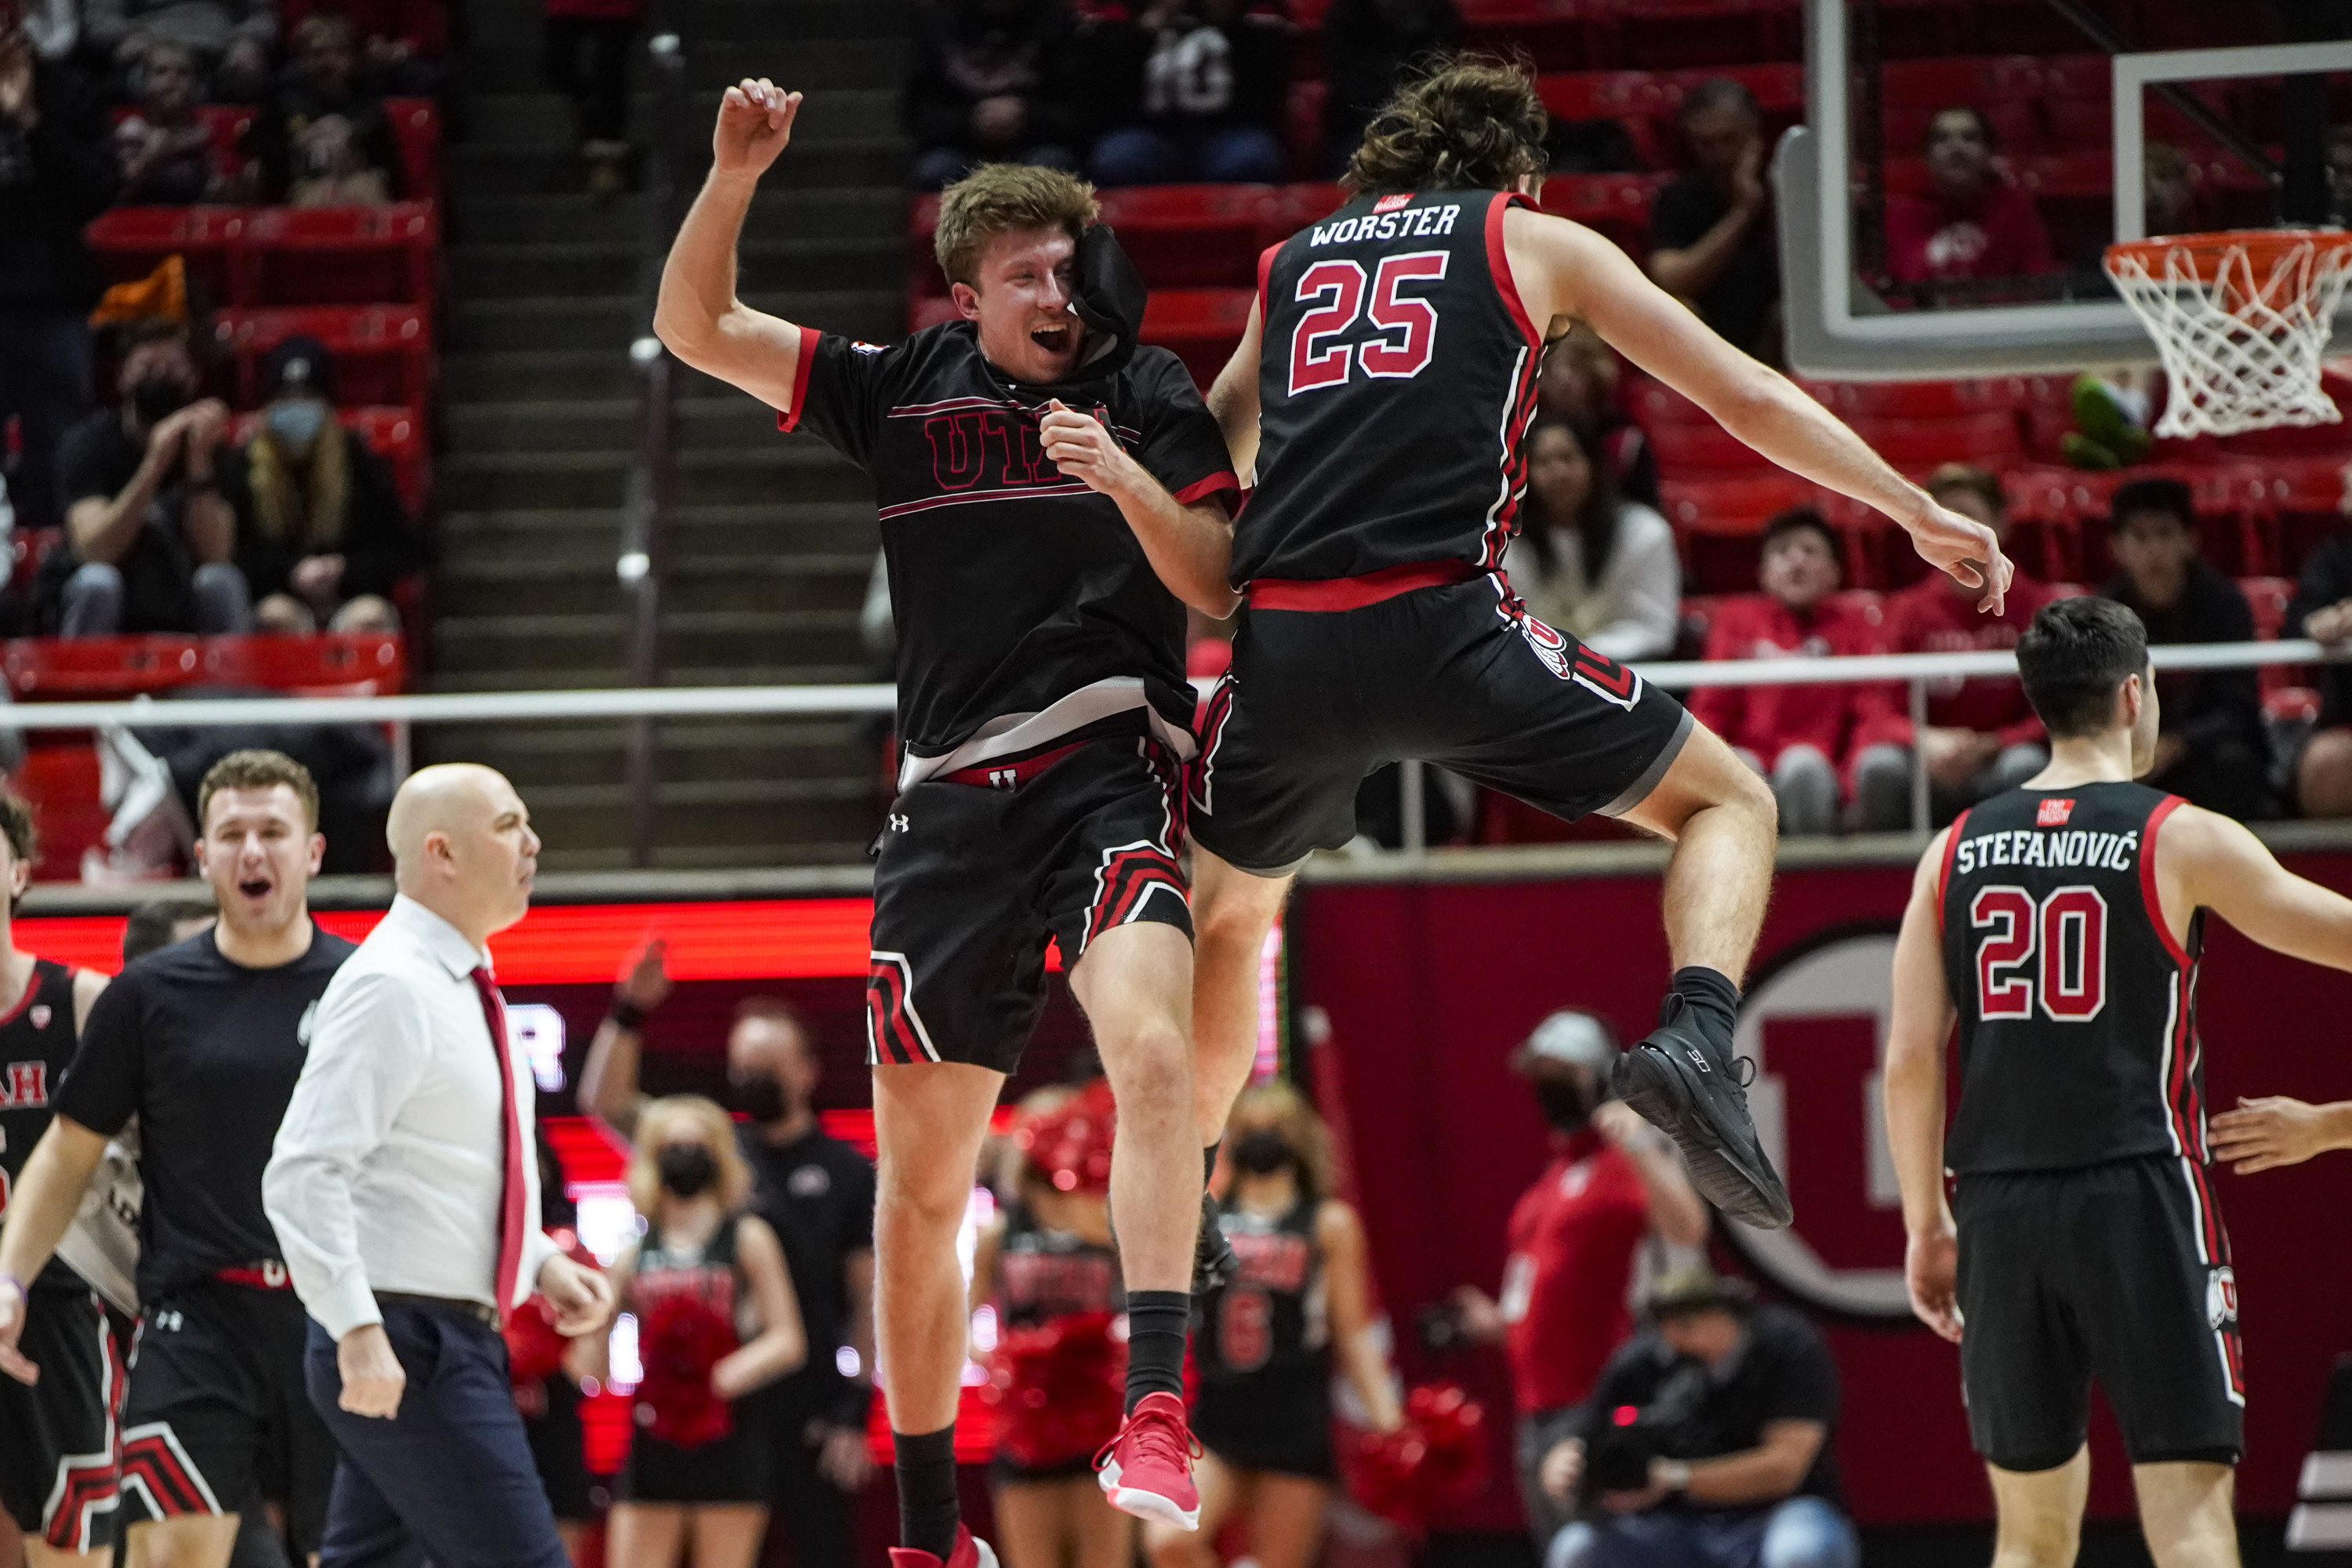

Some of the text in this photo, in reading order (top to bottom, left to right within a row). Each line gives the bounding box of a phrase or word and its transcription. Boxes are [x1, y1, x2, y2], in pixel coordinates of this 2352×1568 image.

[1310, 205, 1461, 248] WORSTER
[1288, 250, 1450, 397] 25
[2038, 809, 2071, 822] RACISM
[2045, 799, 2066, 811] END
[1957, 830, 2138, 874] STEFANOVIĆ
[1970, 885, 2108, 1022] 20
